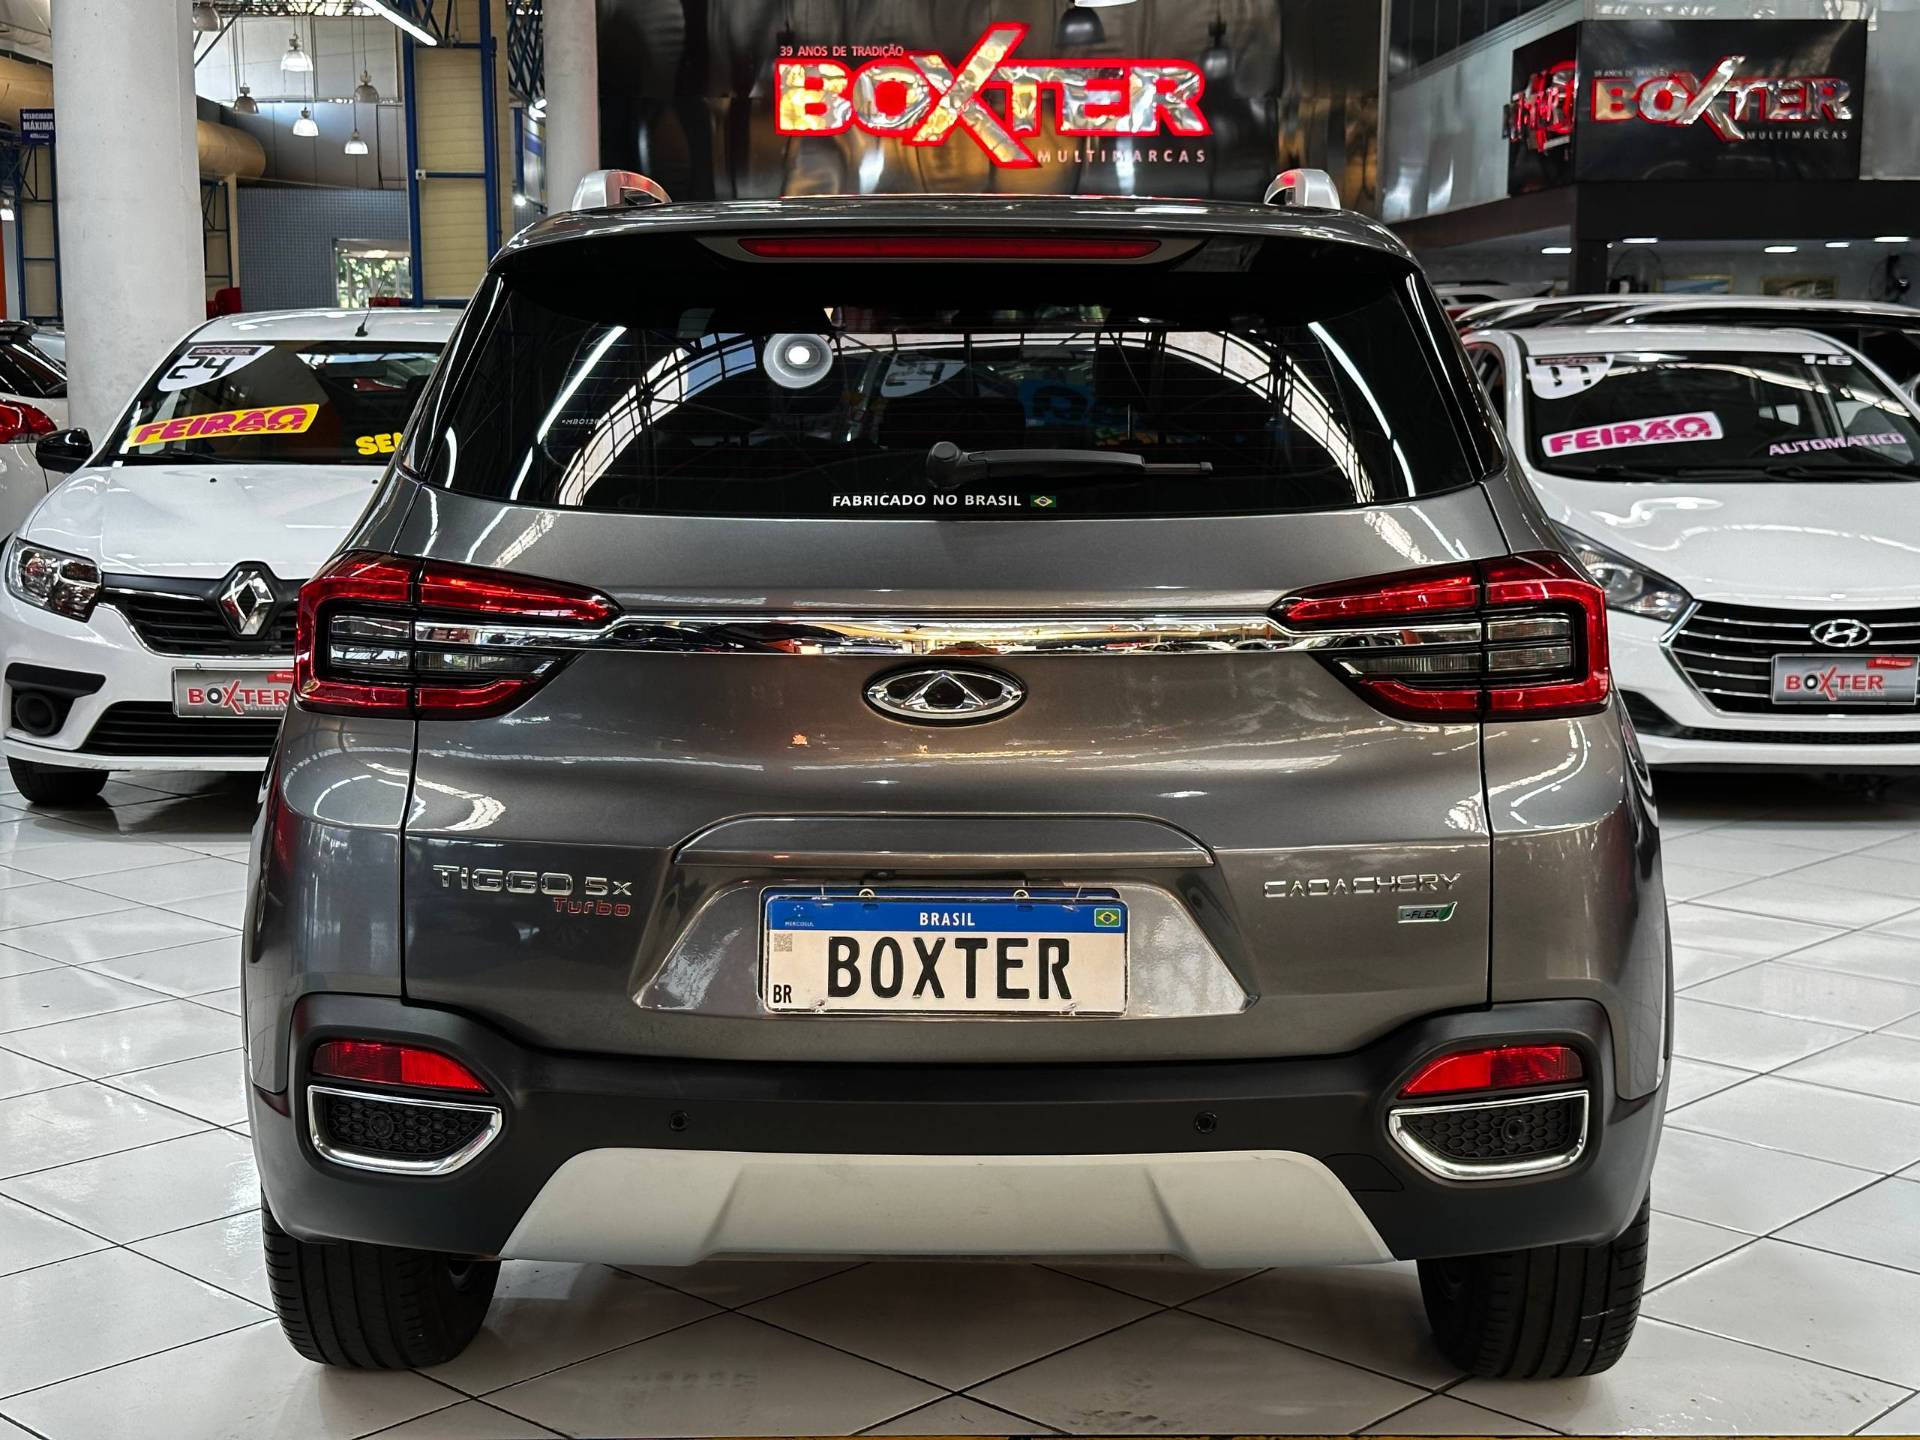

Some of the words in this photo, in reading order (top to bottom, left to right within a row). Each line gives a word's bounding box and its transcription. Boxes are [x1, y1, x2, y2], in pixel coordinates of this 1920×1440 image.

[779, 46, 793, 57] 39
[798, 46, 828, 57] ANOS
[832, 46, 848, 57] DE
[852, 44, 904, 59] TRADIÇÃO
[775, 21, 1213, 168] BOXTER
[1591, 55, 1853, 142] BOXTER
[23, 120, 55, 130] MÁXIMA
[1746, 131, 1849, 141] MULTIMARCAS
[1038, 149, 1207, 163] MULTIMARCAS
[167, 355, 235, 380] 24
[1802, 354, 1852, 366] 1.6
[134, 407, 308, 443] FEIRÃO
[1550, 416, 1712, 453] FEIRÃO
[1769, 433, 1906, 456] AUTOMATICO
[832, 494, 926, 507] FABRICADO
[933, 494, 958, 506] NO
[965, 495, 1022, 506] BRASIL
[1784, 664, 1885, 702] BOXTER
[187, 680, 290, 715] BOXTER
[432, 864, 573, 896] TIGGO
[553, 897, 631, 917] Turbo
[919, 912, 975, 927] BRASIL
[827, 936, 1072, 1000] BOXTER
[773, 985, 792, 1004] BR
